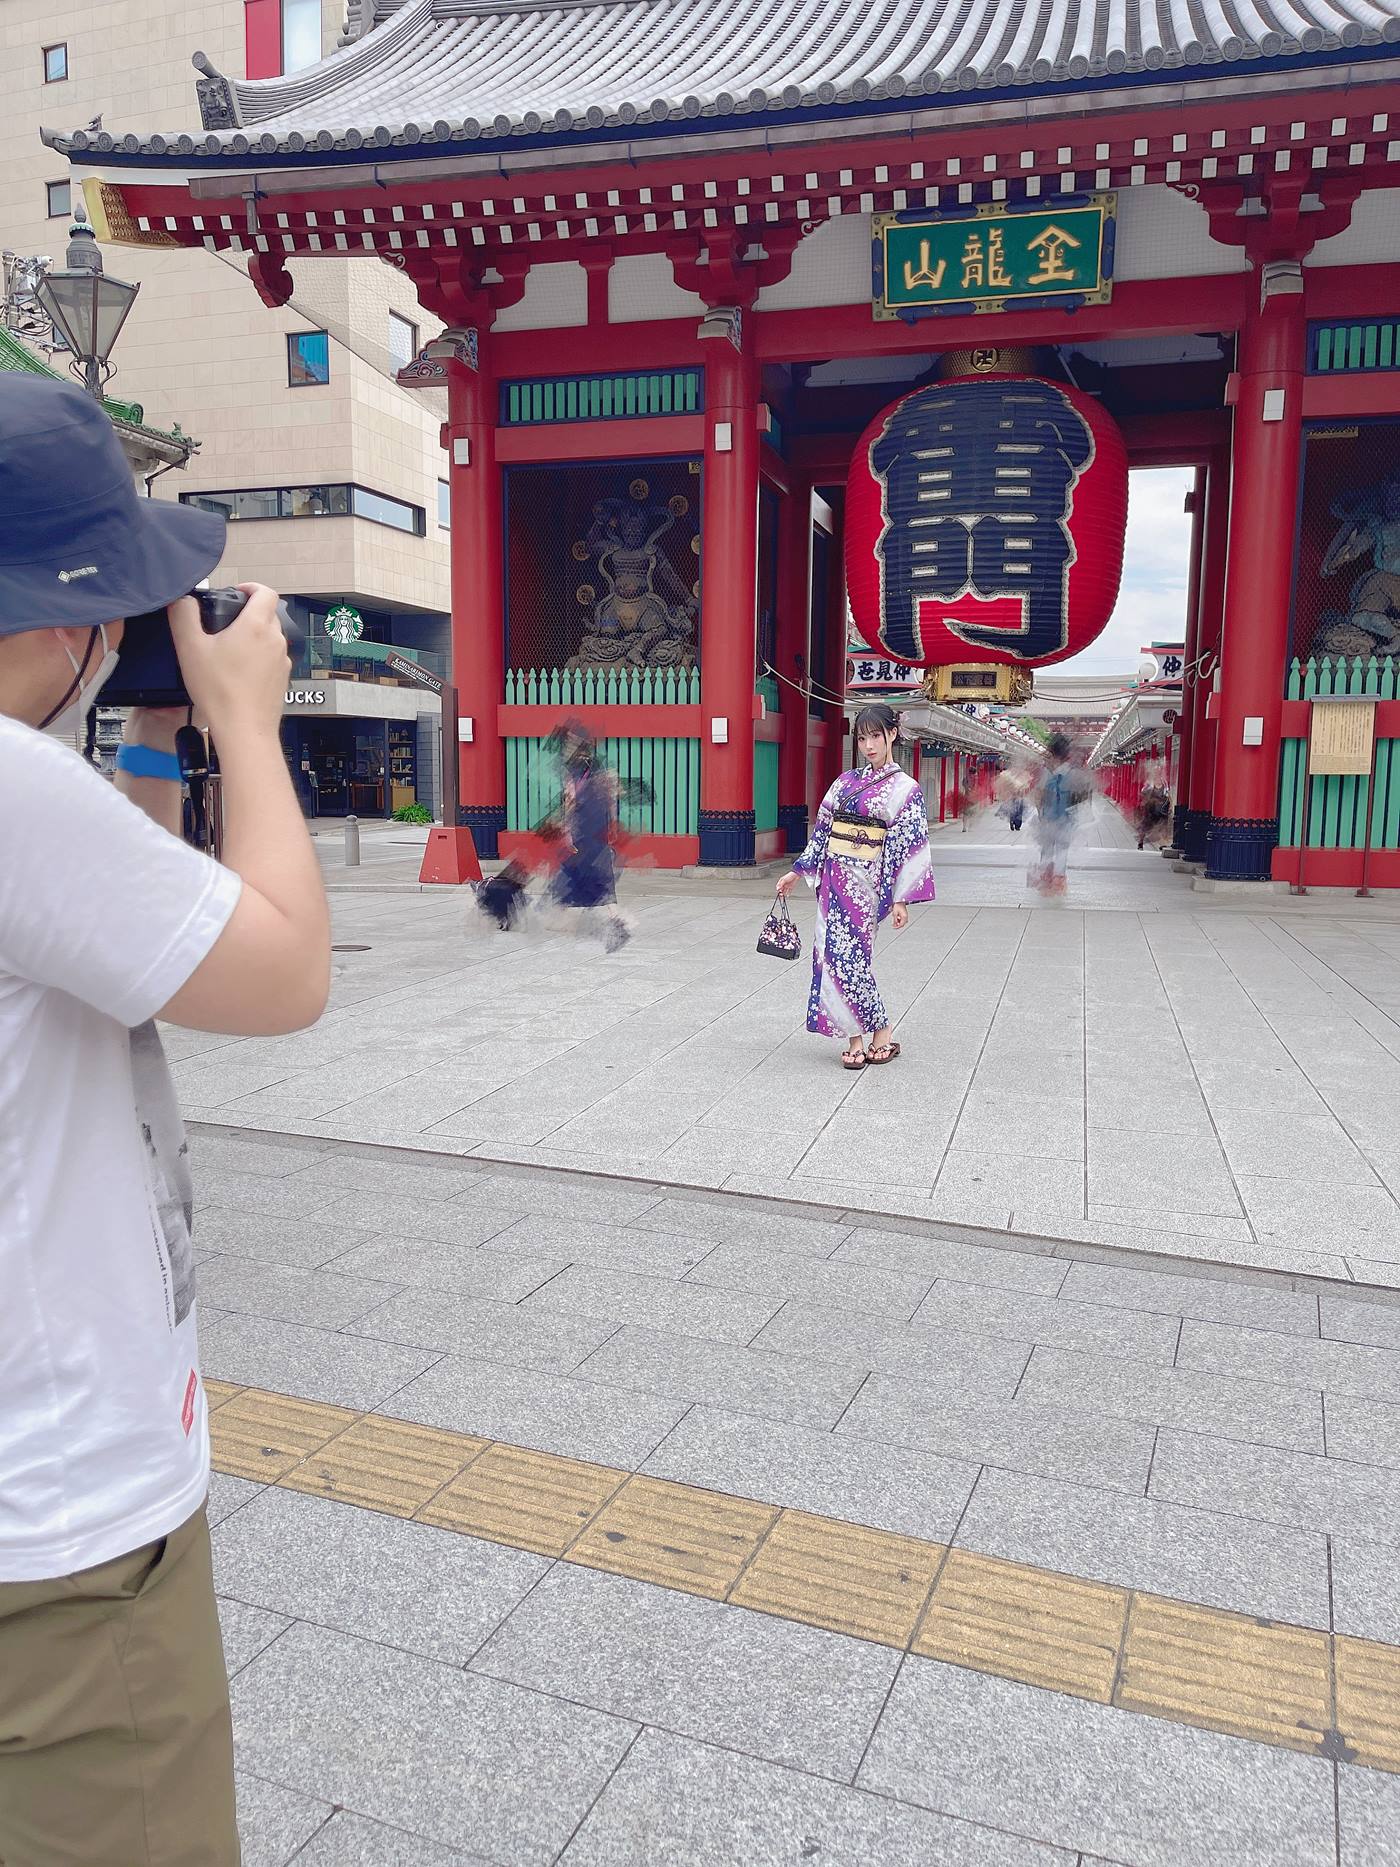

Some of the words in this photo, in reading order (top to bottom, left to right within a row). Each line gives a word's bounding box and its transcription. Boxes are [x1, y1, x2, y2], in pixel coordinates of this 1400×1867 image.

[868, 378, 1097, 662] 雷門
[395, 657, 429, 681] KAMINARIMON
[428, 678, 442, 688] GATE
[284, 691, 325, 704] UCKS
